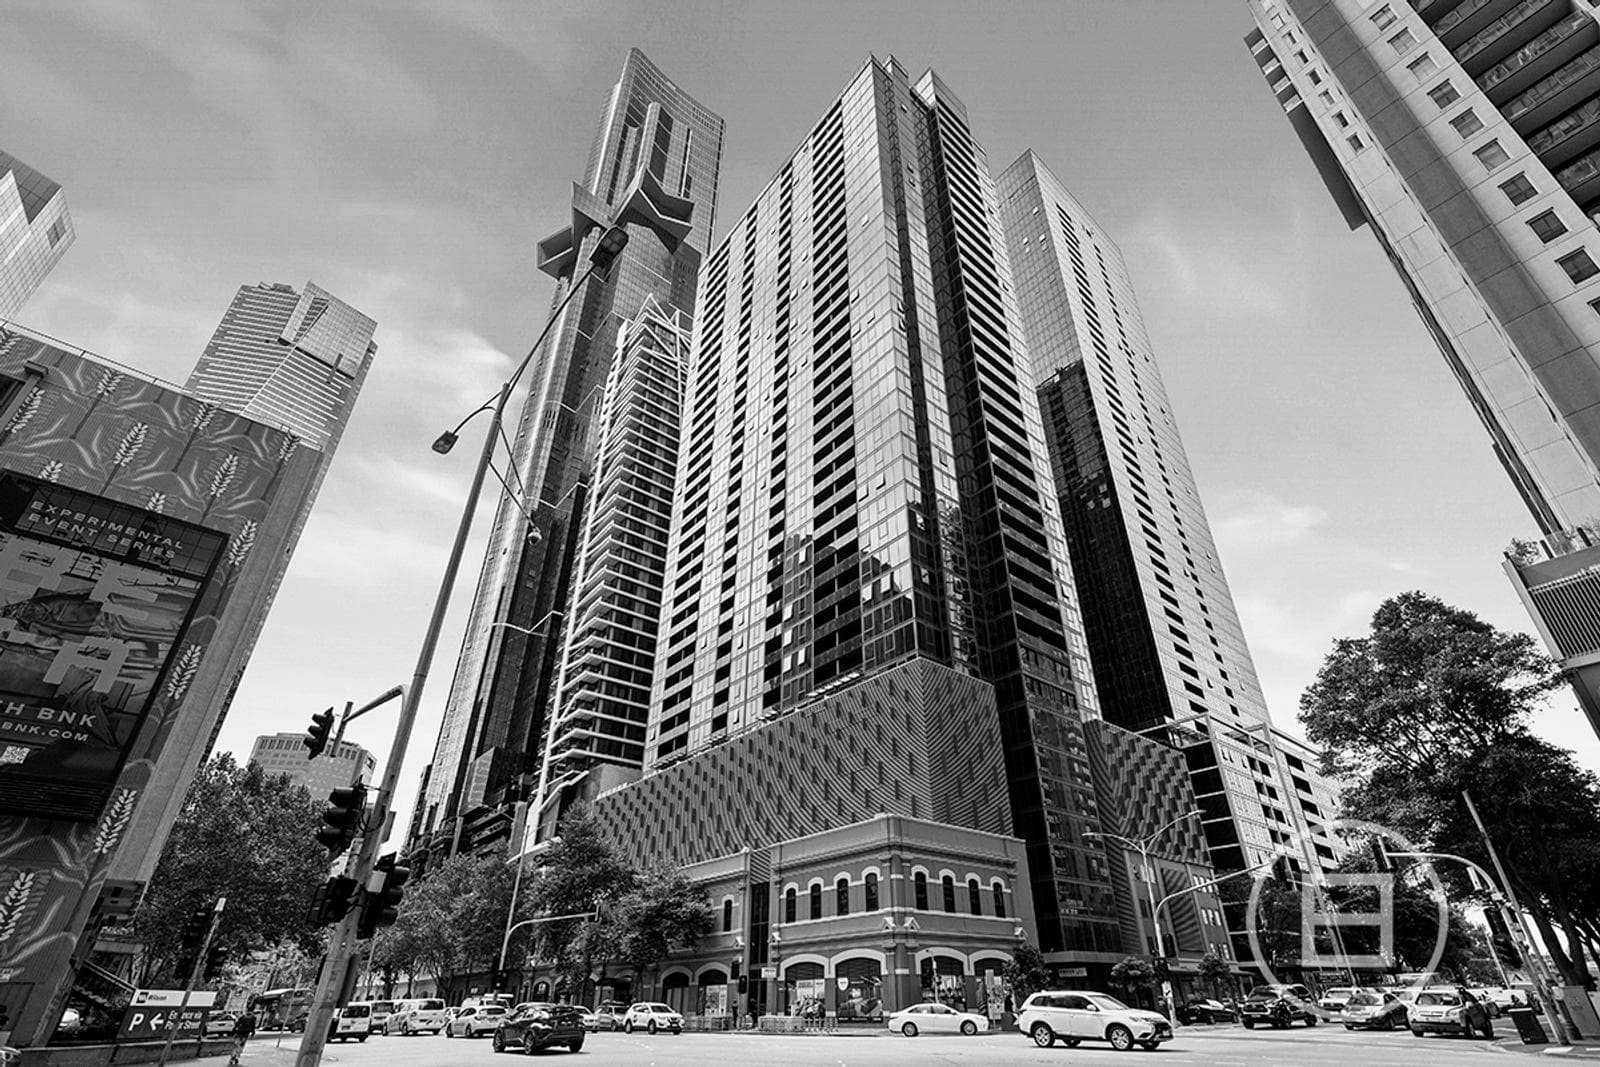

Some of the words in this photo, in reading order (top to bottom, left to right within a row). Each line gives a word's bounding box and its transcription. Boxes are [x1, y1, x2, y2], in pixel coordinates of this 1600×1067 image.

[28, 513, 98, 537] EVENT
[106, 534, 176, 559] SERIES
[31, 501, 183, 550] EXPERIMENTAL
[37, 707, 97, 728] BNK
[127, 1012, 145, 1031] P
